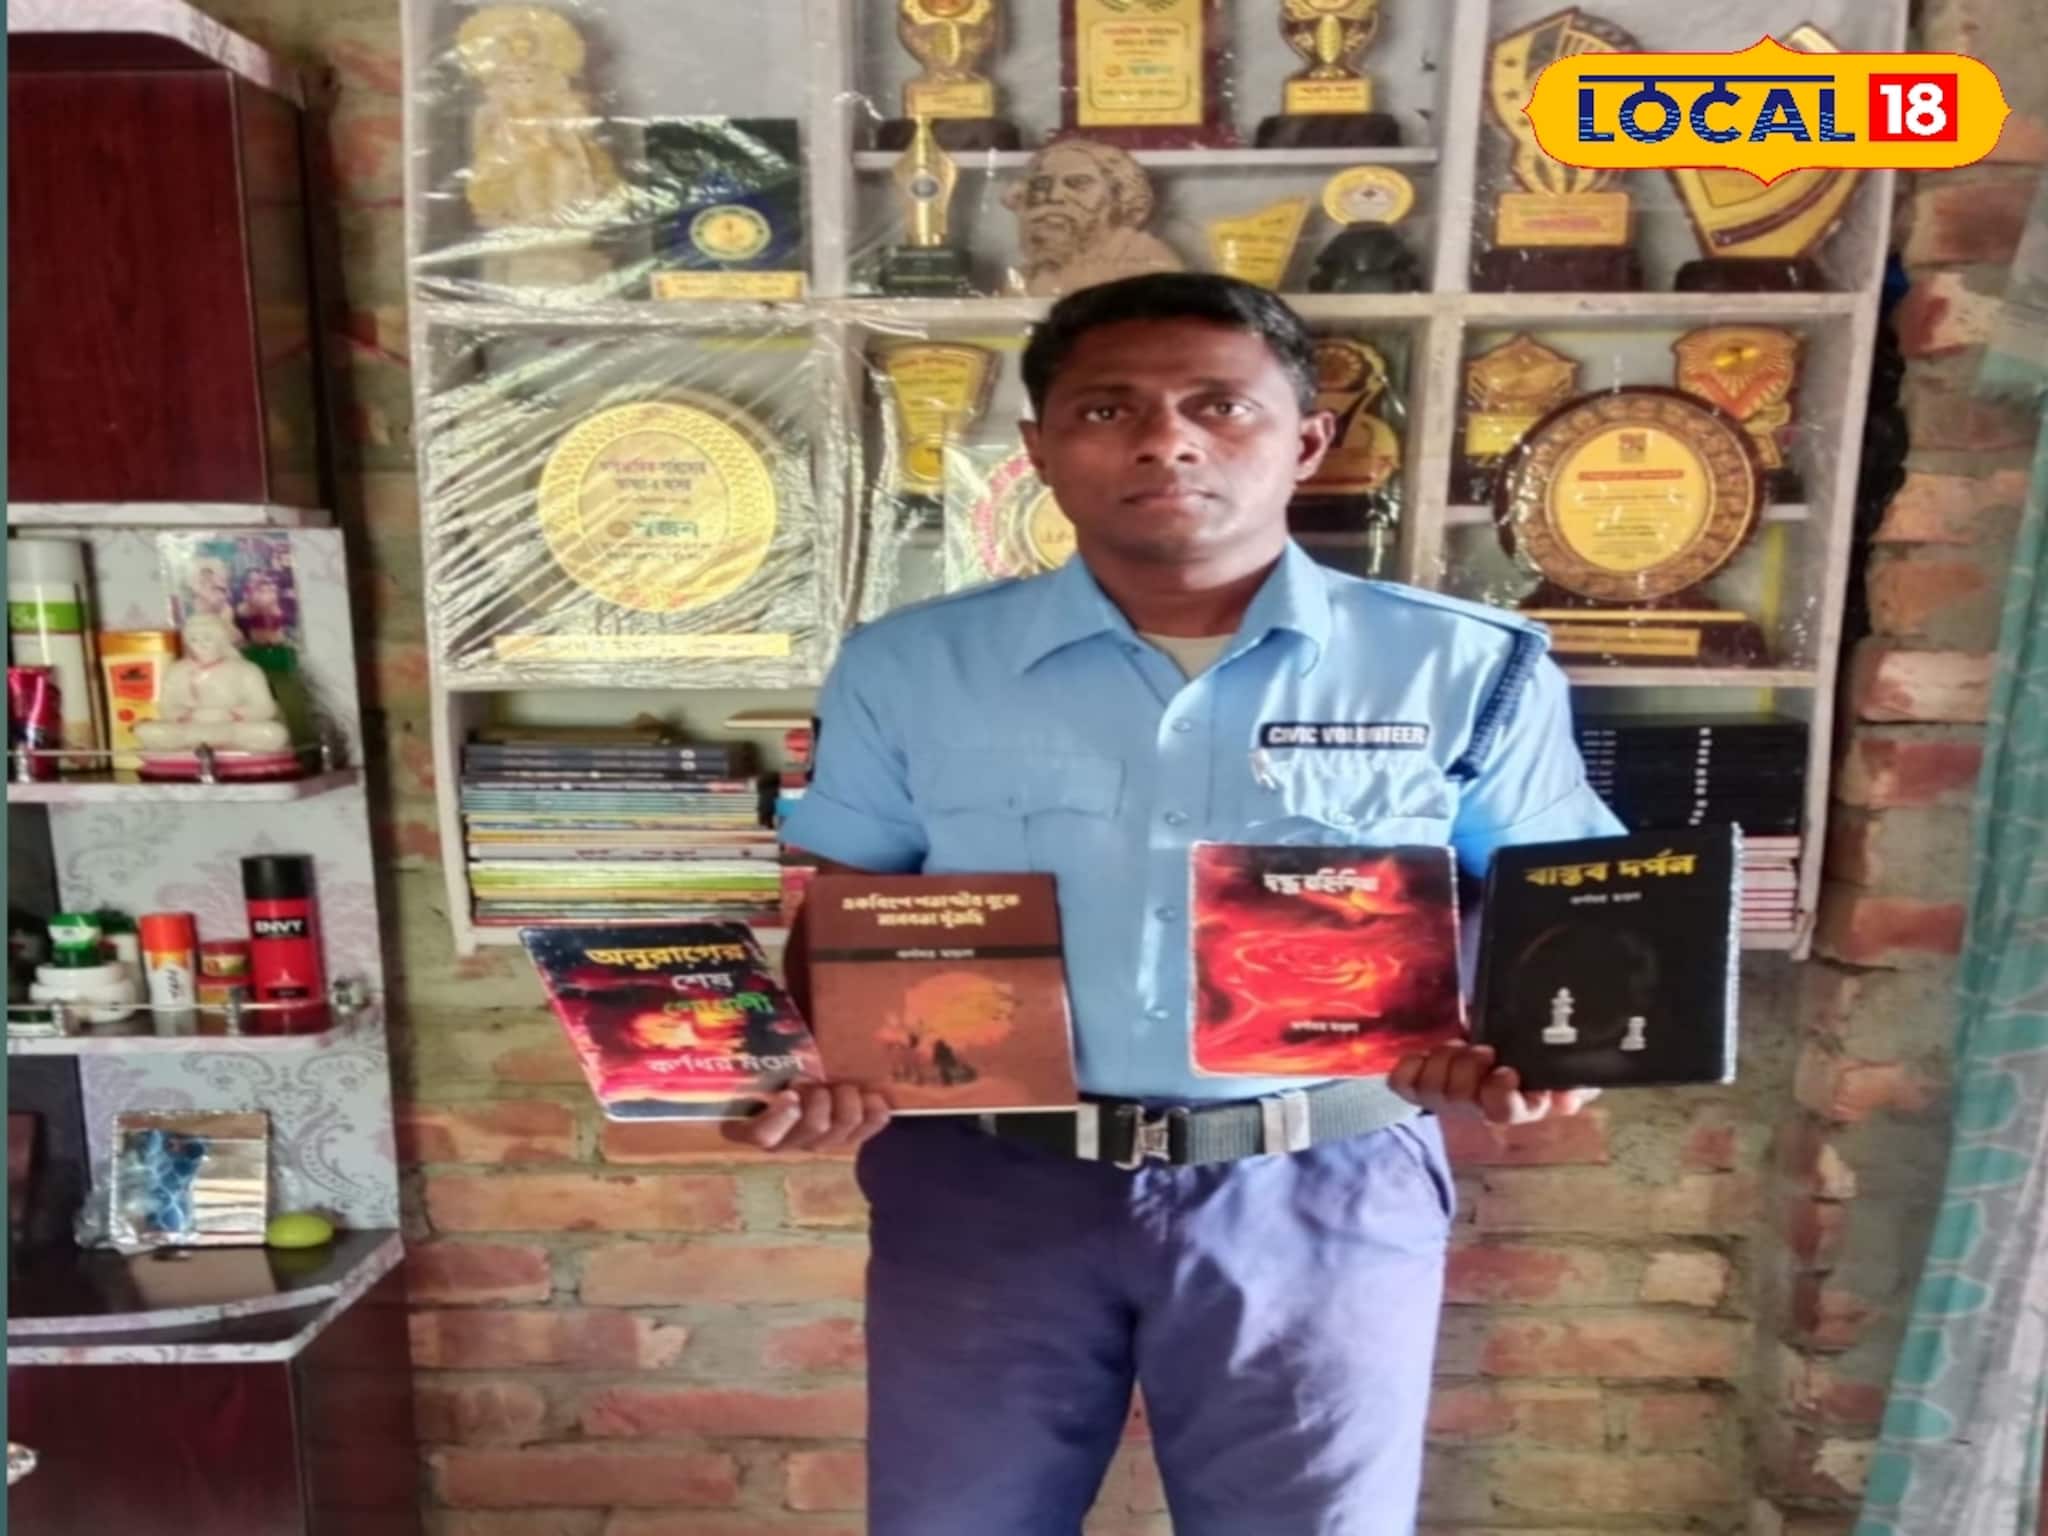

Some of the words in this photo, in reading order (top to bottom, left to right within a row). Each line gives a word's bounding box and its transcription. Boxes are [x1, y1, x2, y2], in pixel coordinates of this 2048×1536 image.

[1268, 725, 1317, 744] CIVIC
[1320, 726, 1426, 745] VOLUNTEER
[1524, 861, 1610, 887] বাস্তব
[1617, 848, 1698, 878] দর্পন
[254, 919, 303, 934] ENVY
[584, 943, 747, 971] অনুরাগের
[670, 971, 735, 991] শেষ
